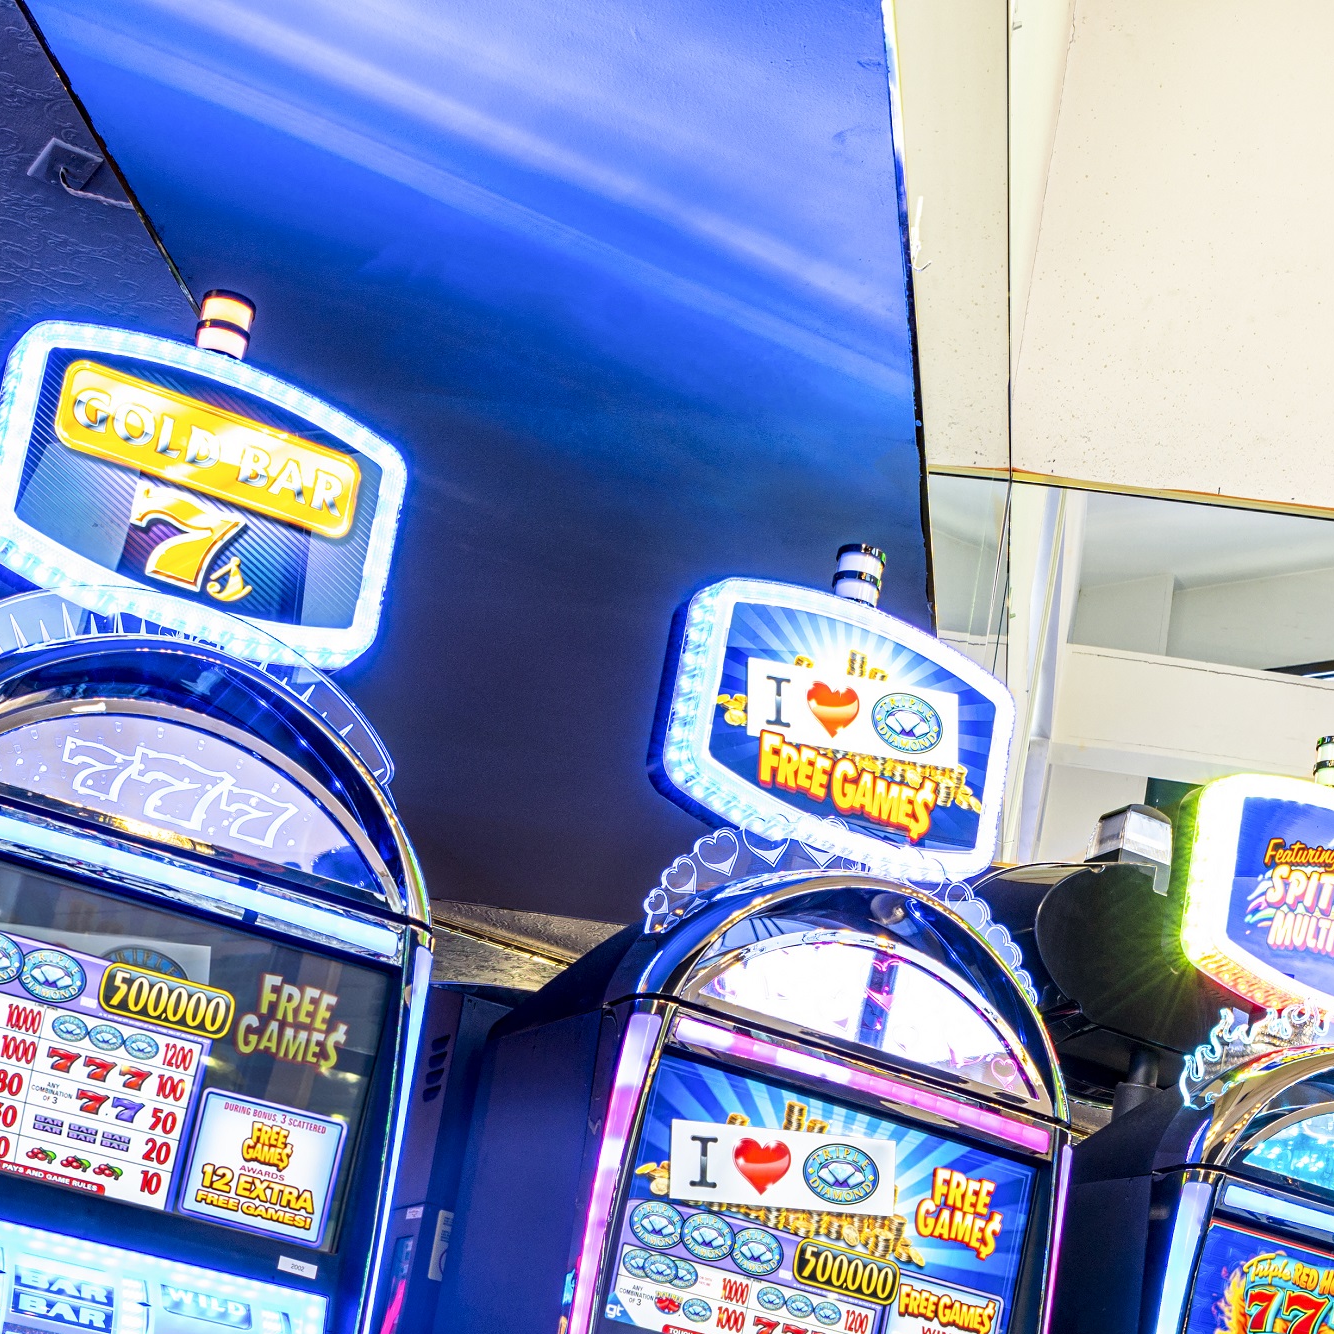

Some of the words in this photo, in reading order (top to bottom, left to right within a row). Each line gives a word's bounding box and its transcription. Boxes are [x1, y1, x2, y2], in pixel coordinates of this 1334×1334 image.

[72, 386, 220, 468] GOLD
[237, 444, 344, 518] BAR
[759, 730, 832, 800] FREE
[109, 971, 226, 1032] 500,000
[259, 973, 338, 1029] FREE
[1, 1035, 37, 1064] 1000
[162, 1043, 193, 1071] 1200
[156, 1074, 185, 1101] 100
[149, 1107, 177, 1134] 50
[224, 1102, 251, 1116] DURING
[281, 1114, 286, 1124] 3
[288, 1119, 326, 1134] SCATTERED
[142, 1138, 171, 1165] 20
[2, 1163, 24, 1174] PAYS
[26, 1169, 44, 1179] AND
[46, 1174, 69, 1185] GAME
[72, 1180, 97, 1192] RULES
[140, 1170, 161, 1195] 10
[201, 1163, 234, 1193] 12
[235, 1173, 314, 1214] EXTRA
[932, 1167, 996, 1211] FREE
[195, 1189, 239, 1211] FREE
[241, 1202, 312, 1230] GAMES!
[802, 1246, 894, 1300] 500,000
[1243, 1254, 1290, 1282] Triple
[1292, 1264, 1318, 1290] RED
[899, 1283, 939, 1322] FREE
